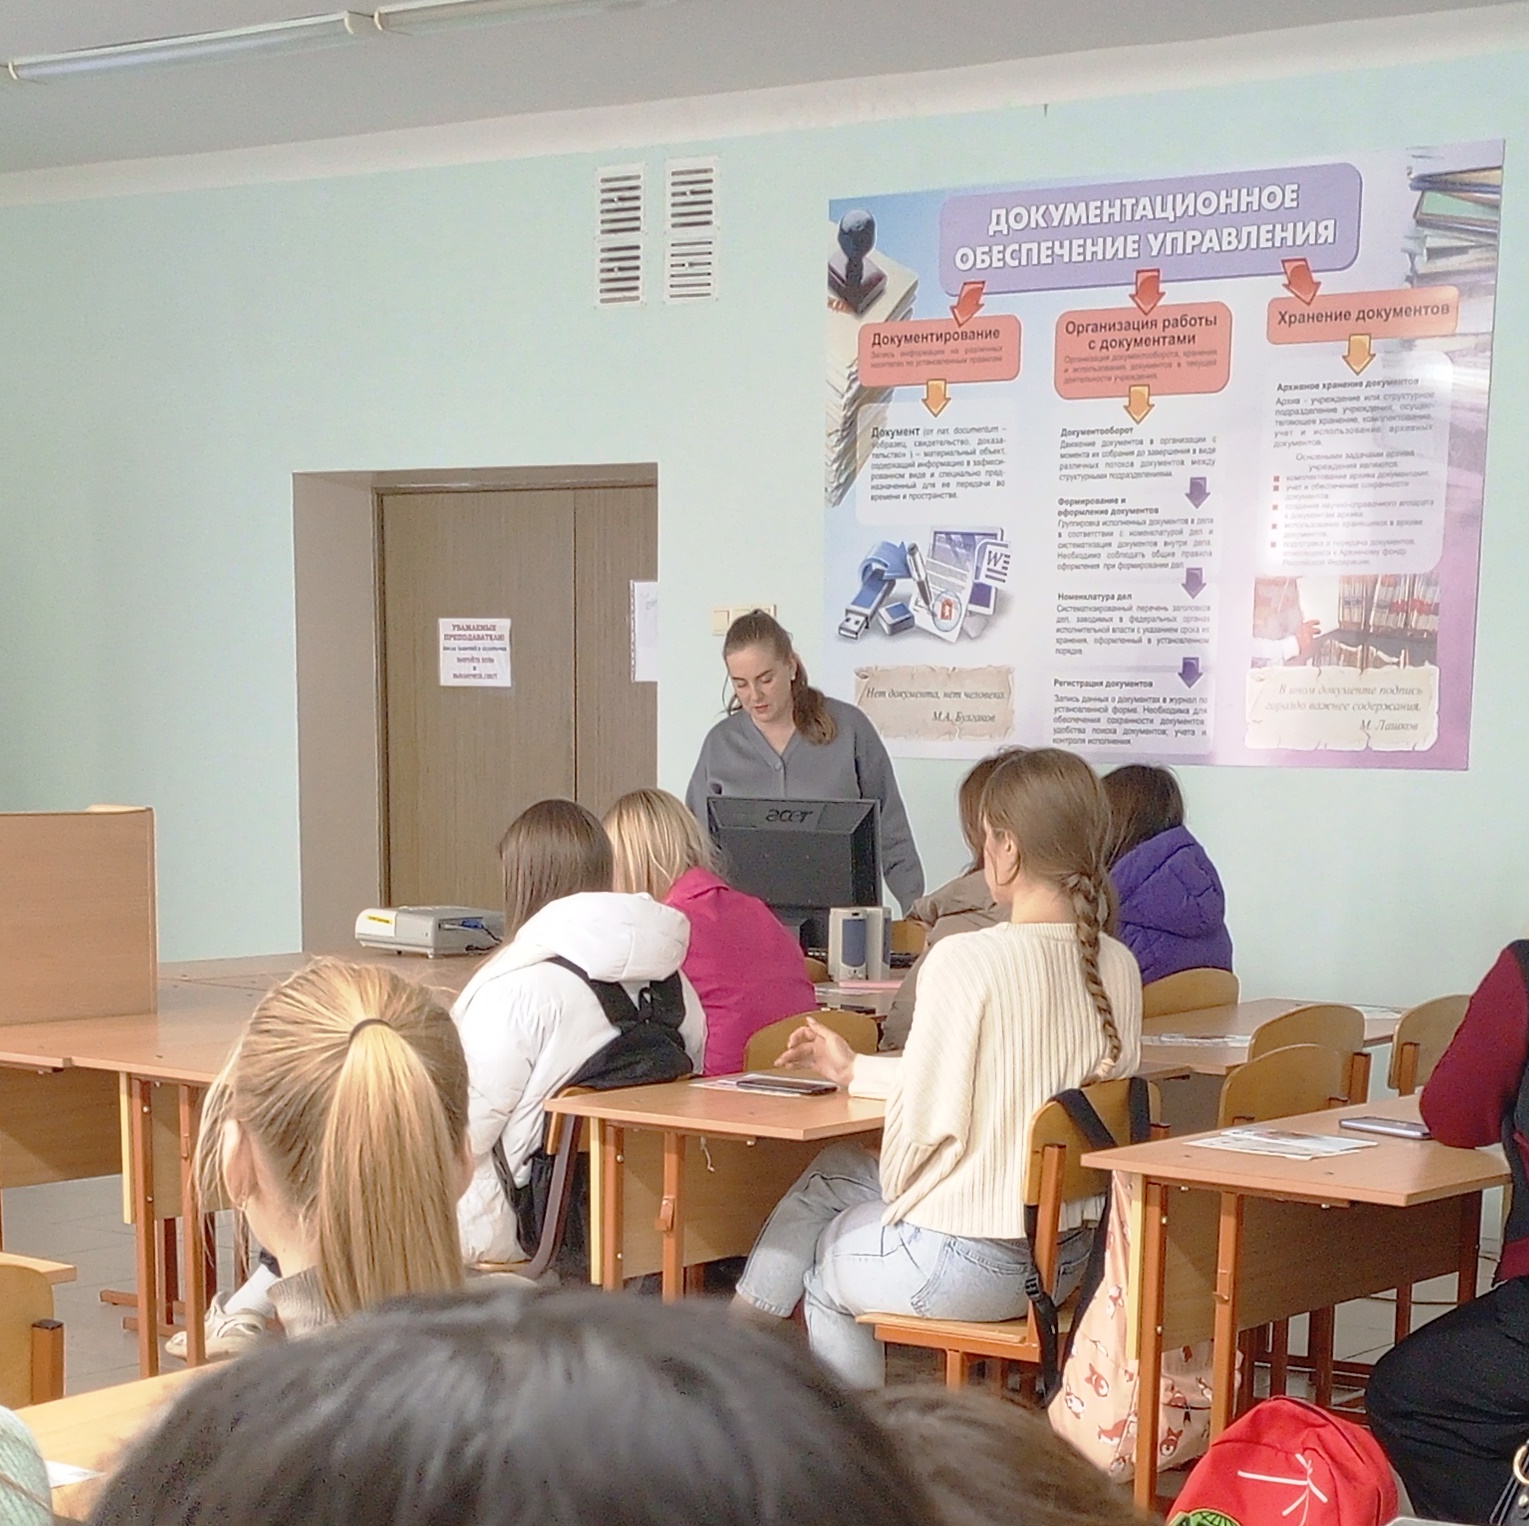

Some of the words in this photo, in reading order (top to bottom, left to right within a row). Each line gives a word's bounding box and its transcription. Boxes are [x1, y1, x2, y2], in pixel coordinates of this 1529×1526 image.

[988, 184, 1299, 235] ДОКУМЕНТАЦИОННОЕ
[954, 234, 1140, 270] ОБЕСПЕЧЕНИЕ
[1148, 220, 1336, 256] УПРАВЛЕНИЯ
[1278, 311, 1351, 327] Хранение
[1355, 304, 1450, 322] документов
[1065, 319, 1157, 337] Организация
[1162, 314, 1217, 330] работы
[872, 329, 1000, 348] Документирование
[1089, 340, 1095, 349] с
[1100, 334, 1196, 351] документами
[1323, 381, 1363, 390] хранение
[1365, 378, 1419, 388] документов
[872, 427, 920, 438] Документ
[1061, 427, 1133, 438] Документооборот
[1058, 498, 1118, 506] Формирование
[1110, 507, 1159, 516] документов
[1058, 593, 1115, 602] Номенклатура
[1117, 593, 1132, 601] дел
[1054, 679, 1103, 687] Регистрация
[866, 687, 886, 698] Нет
[1318, 685, 1376, 696] документе
[1379, 686, 1422, 696] подпись
[1309, 703, 1349, 711] важнее
[766, 809, 813, 822] acer
